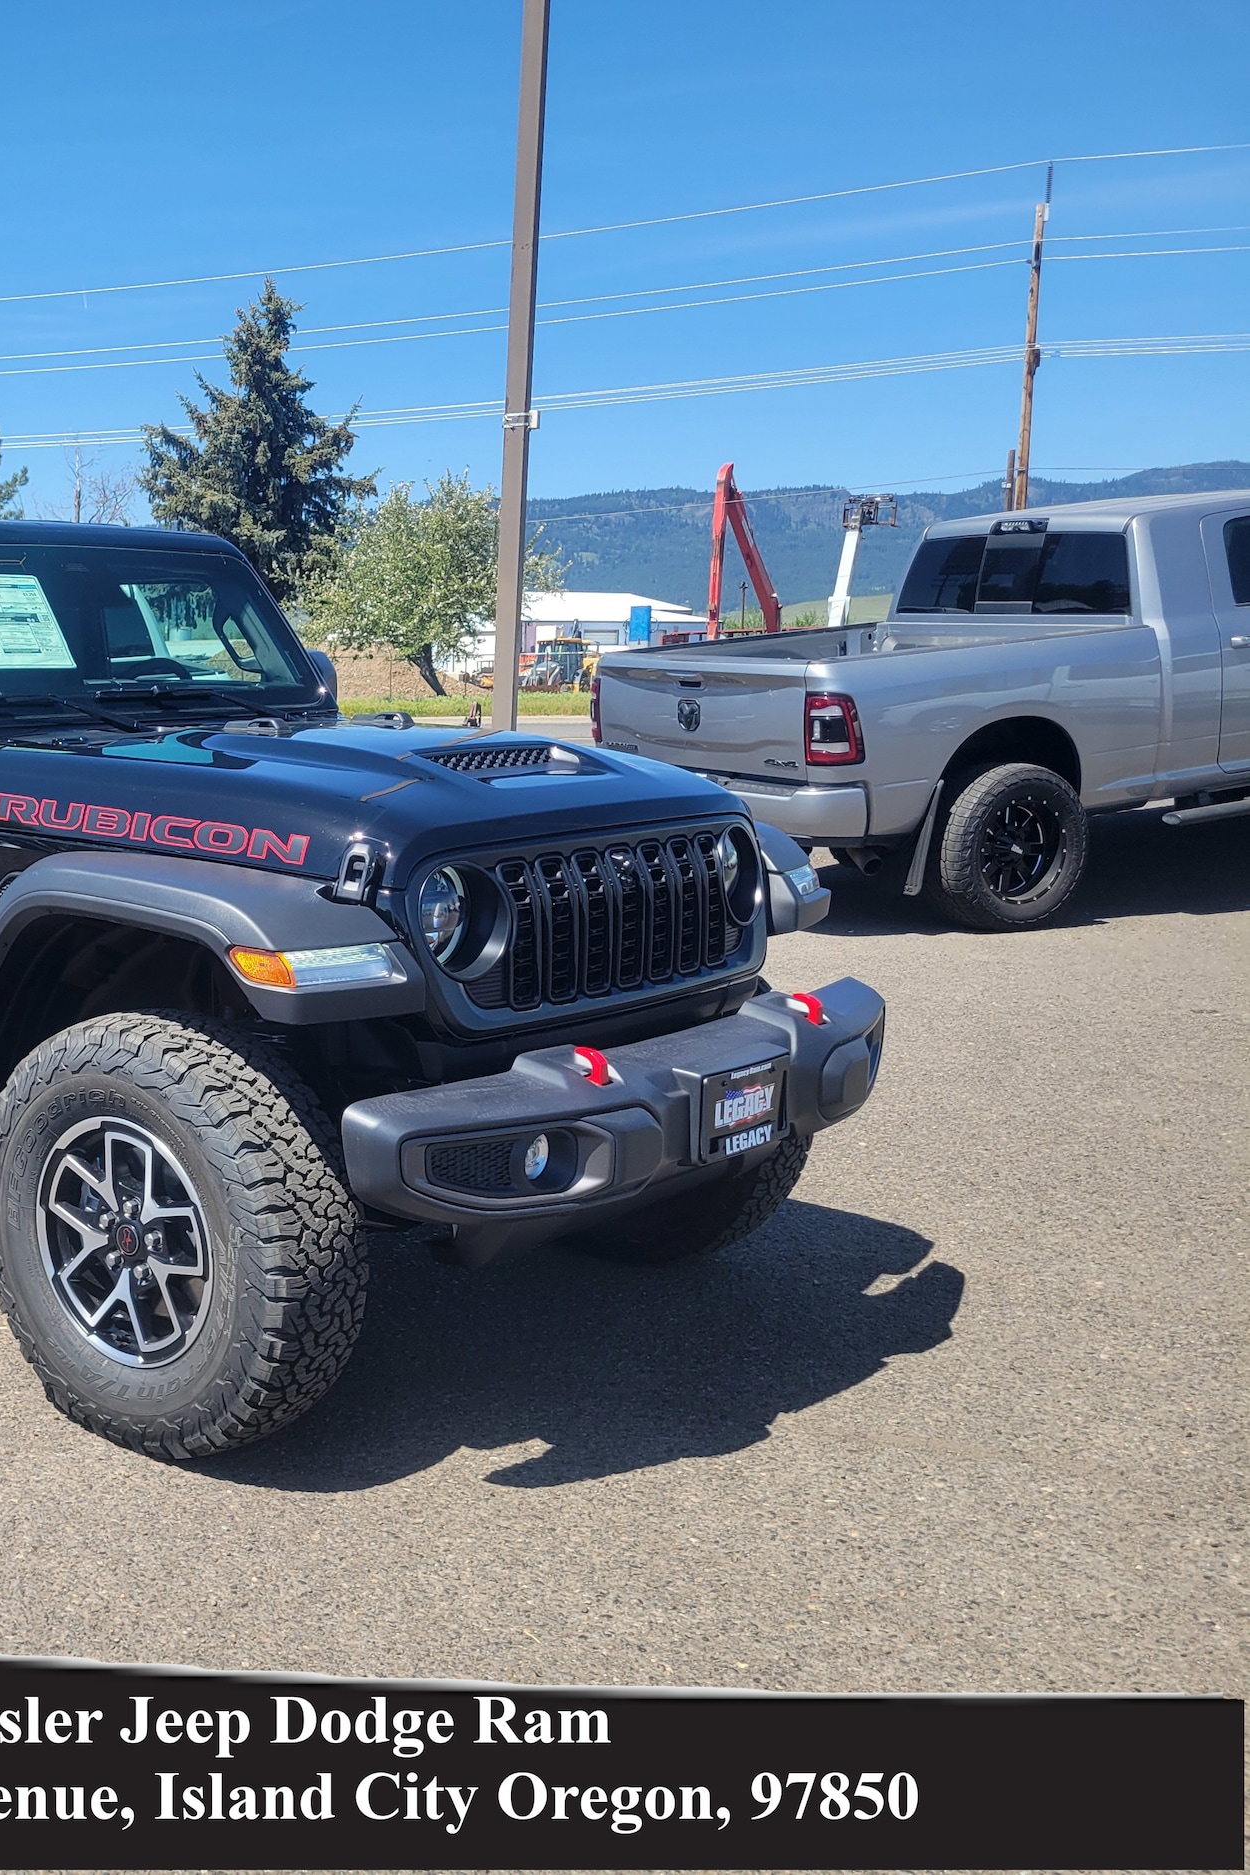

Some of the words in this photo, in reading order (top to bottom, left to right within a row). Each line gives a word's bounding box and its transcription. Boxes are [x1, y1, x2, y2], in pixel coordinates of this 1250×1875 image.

[714, 1084, 775, 1129] LEGACY
[7, 1086, 126, 1230] BFGoodrich
[725, 1123, 772, 1156] LEGACY
